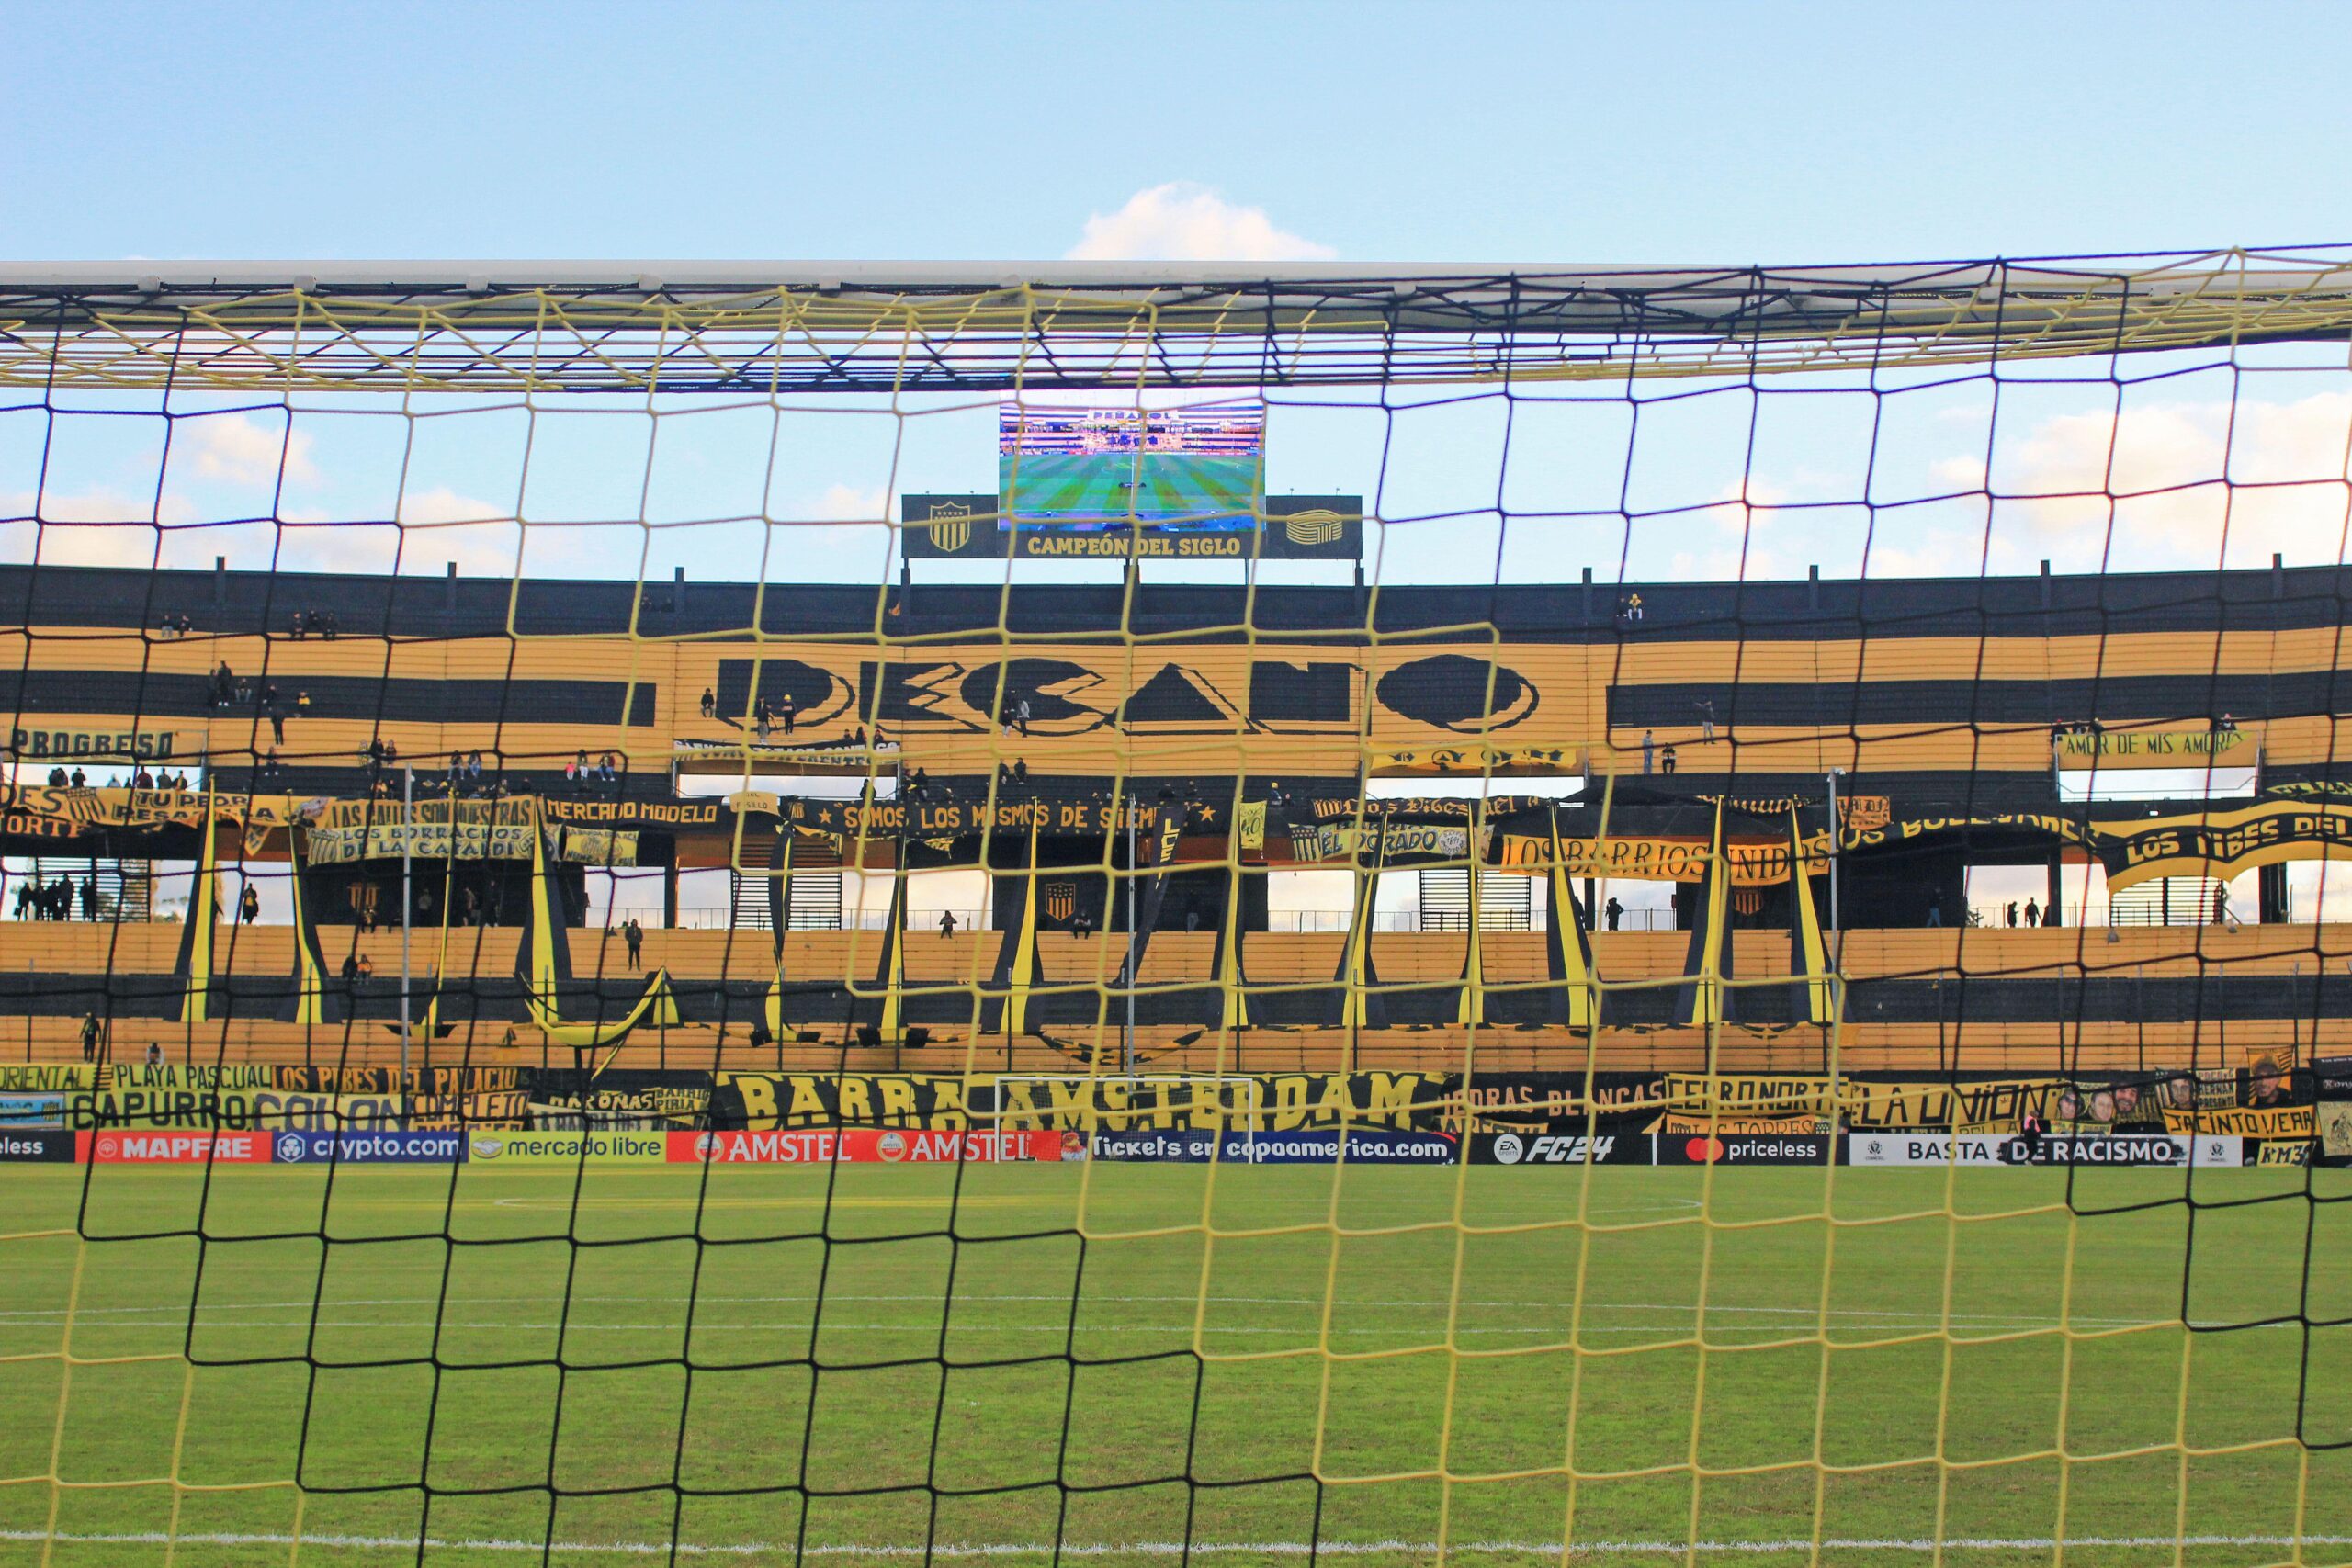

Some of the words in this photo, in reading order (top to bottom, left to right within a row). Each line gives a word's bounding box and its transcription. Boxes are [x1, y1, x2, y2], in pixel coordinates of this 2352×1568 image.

[1028, 533, 1129, 556] CAMPEÓN
[1136, 538, 1173, 556] DEL
[1180, 537, 1241, 556] SIGLO
[15, 729, 175, 760] PROGRESO
[2118, 735, 2138, 754] DE
[2148, 734, 2174, 754] MIS
[547, 799, 637, 821] MERCADO
[640, 803, 718, 824] MODELO
[844, 807, 909, 828] SOMOS
[921, 807, 961, 829] LOS
[1061, 806, 1089, 828] DE
[1322, 831, 1343, 855] EL
[2127, 831, 2181, 865] LOS
[1725, 838, 1829, 880] NIDOS
[116, 1065, 177, 1089] PLAYA
[186, 1065, 272, 1089] PASCUAL
[73, 1091, 249, 1131] CAPURRO
[736, 1076, 970, 1132] BARRA
[1001, 1073, 1418, 1133] AMSTERDAM
[1861, 1086, 1908, 1126] LA
[123, 1138, 252, 1158] MAPFRE
[313, 1136, 462, 1160] crypto.com
[508, 1136, 607, 1156] mercado
[613, 1136, 661, 1156] libre
[728, 1134, 852, 1162] AMSTEL
[910, 1134, 1033, 1162] AMSTEL
[1091, 1135, 1182, 1157] Tickets
[1194, 1140, 1218, 1156] en
[1227, 1136, 1448, 1163] copaamerica.com
[1729, 1140, 1817, 1160] priceless
[1908, 1142, 1990, 1160] BASTA
[2053, 1141, 2172, 1161] RACISMO
